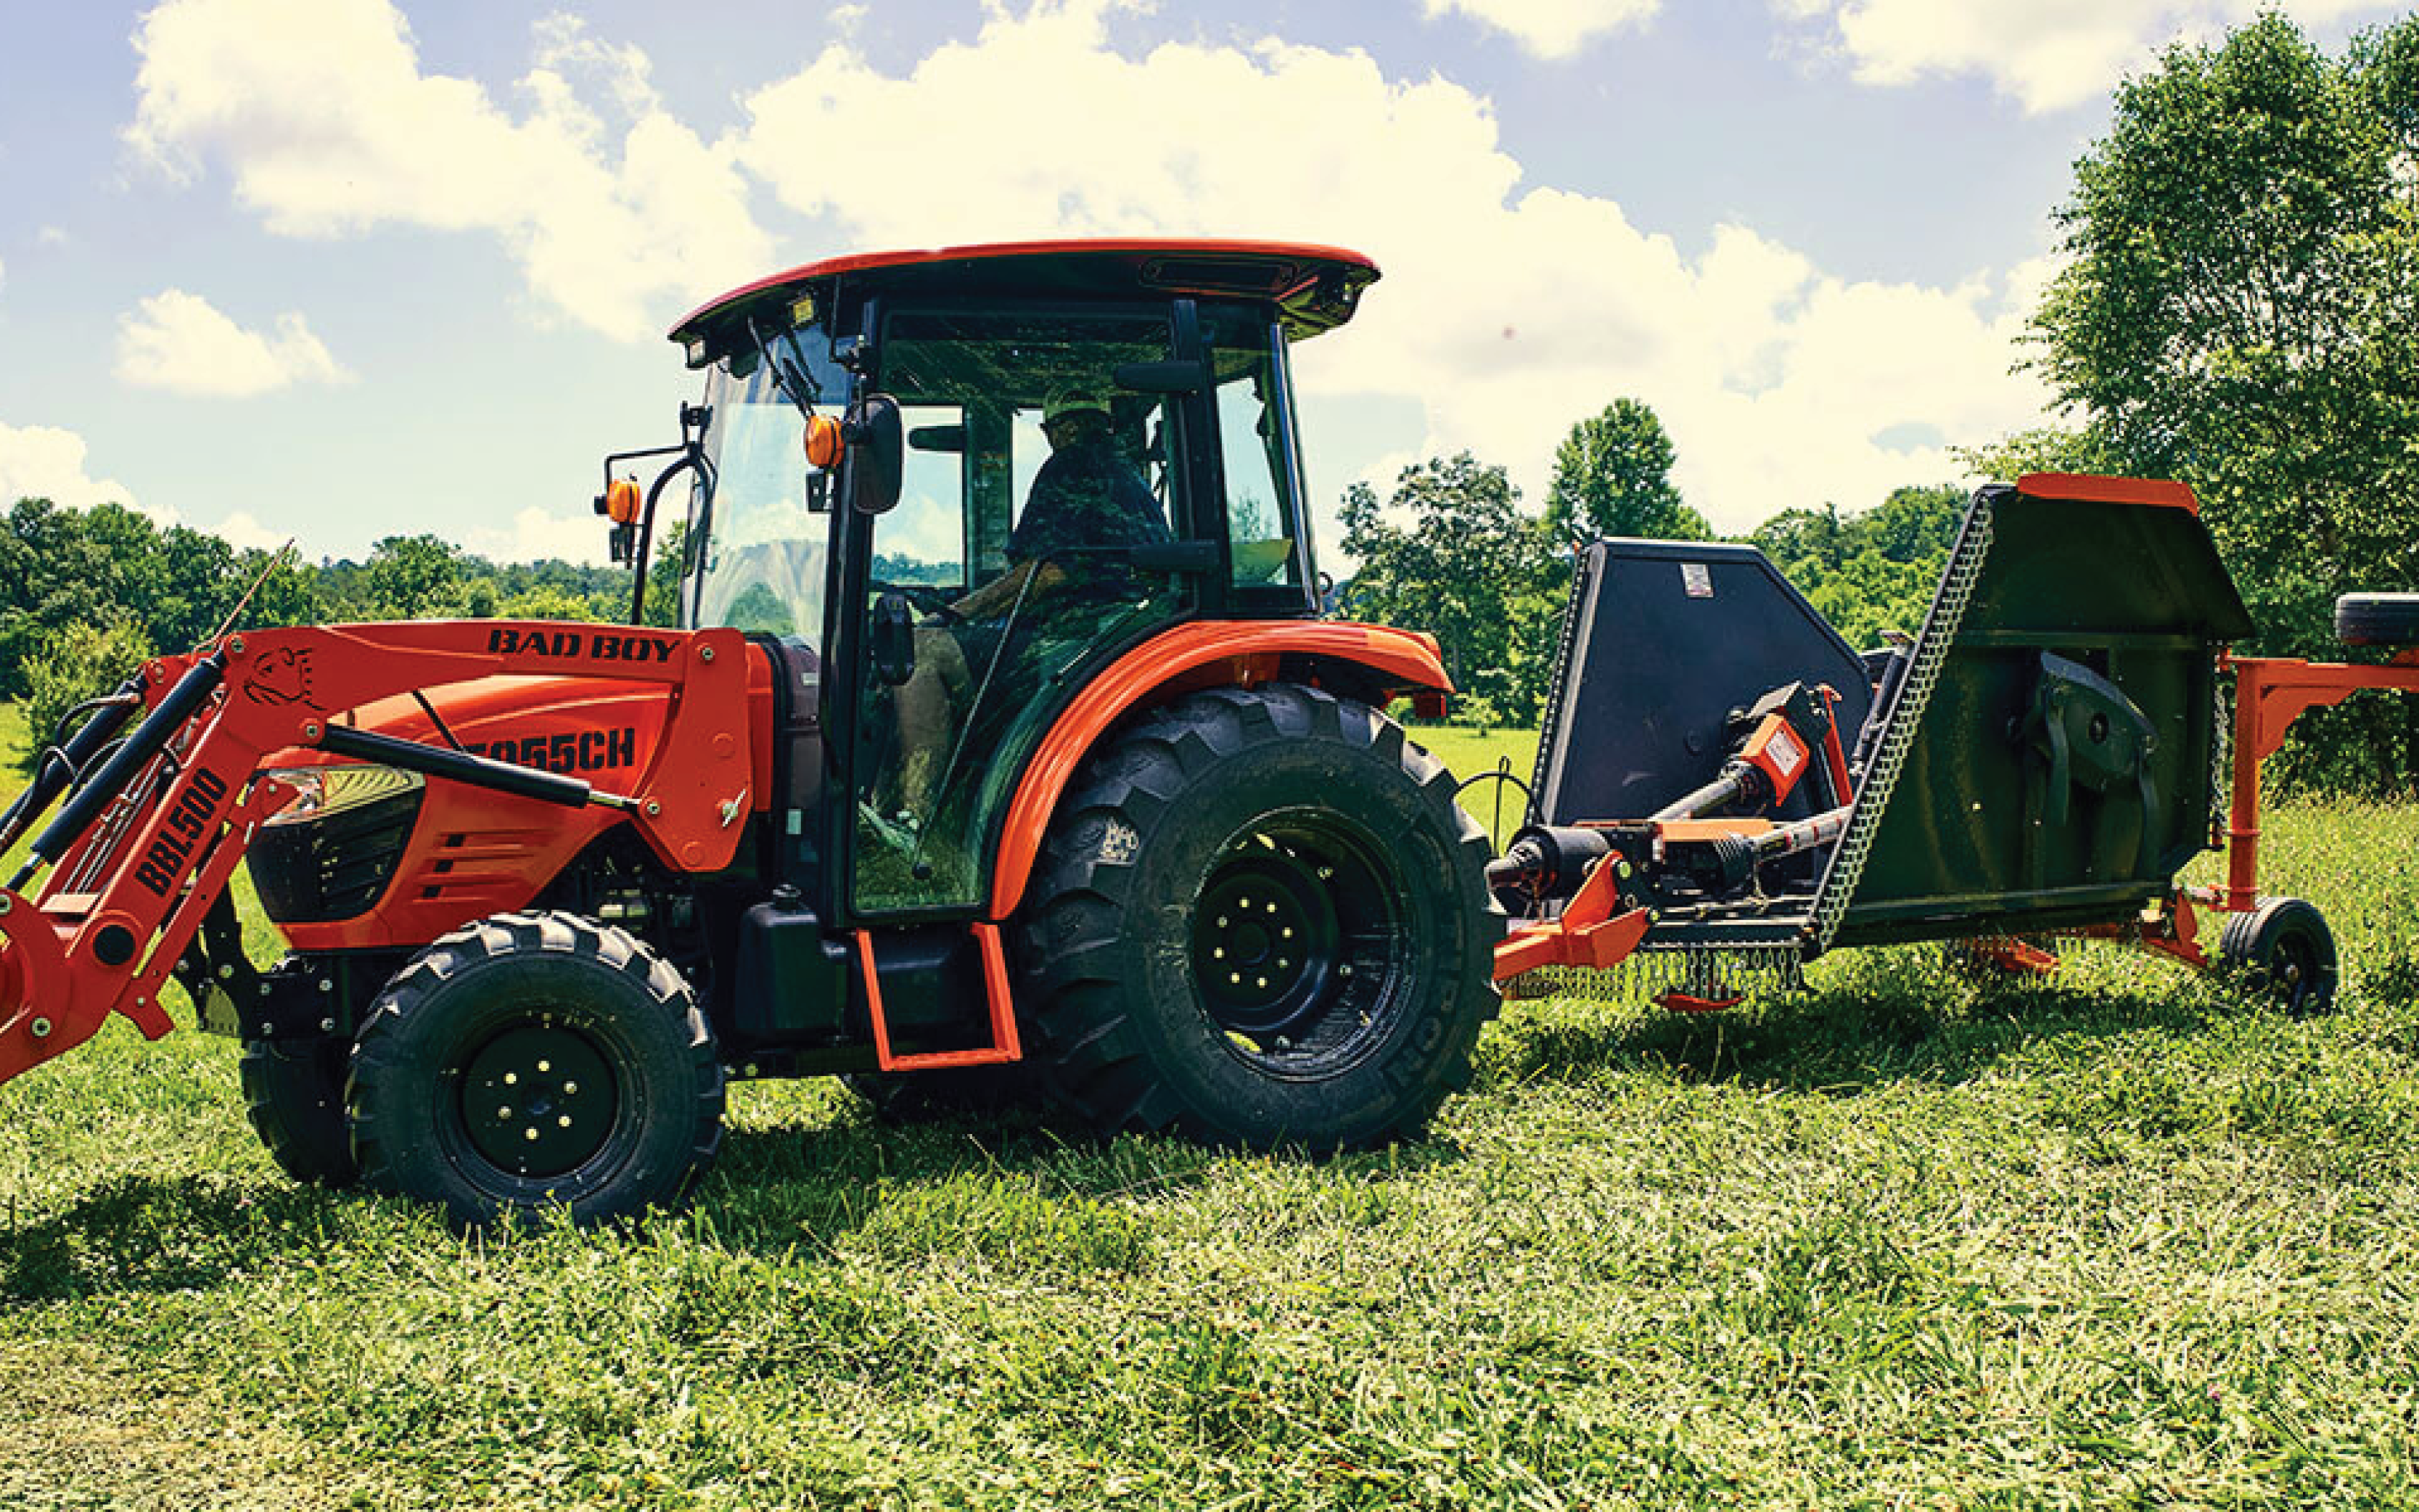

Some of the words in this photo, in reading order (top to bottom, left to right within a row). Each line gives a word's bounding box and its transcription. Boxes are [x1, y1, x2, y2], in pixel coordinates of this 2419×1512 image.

[488, 629, 580, 656] BAD
[591, 635, 681, 662] BOY
[135, 768, 227, 897] BBL500
